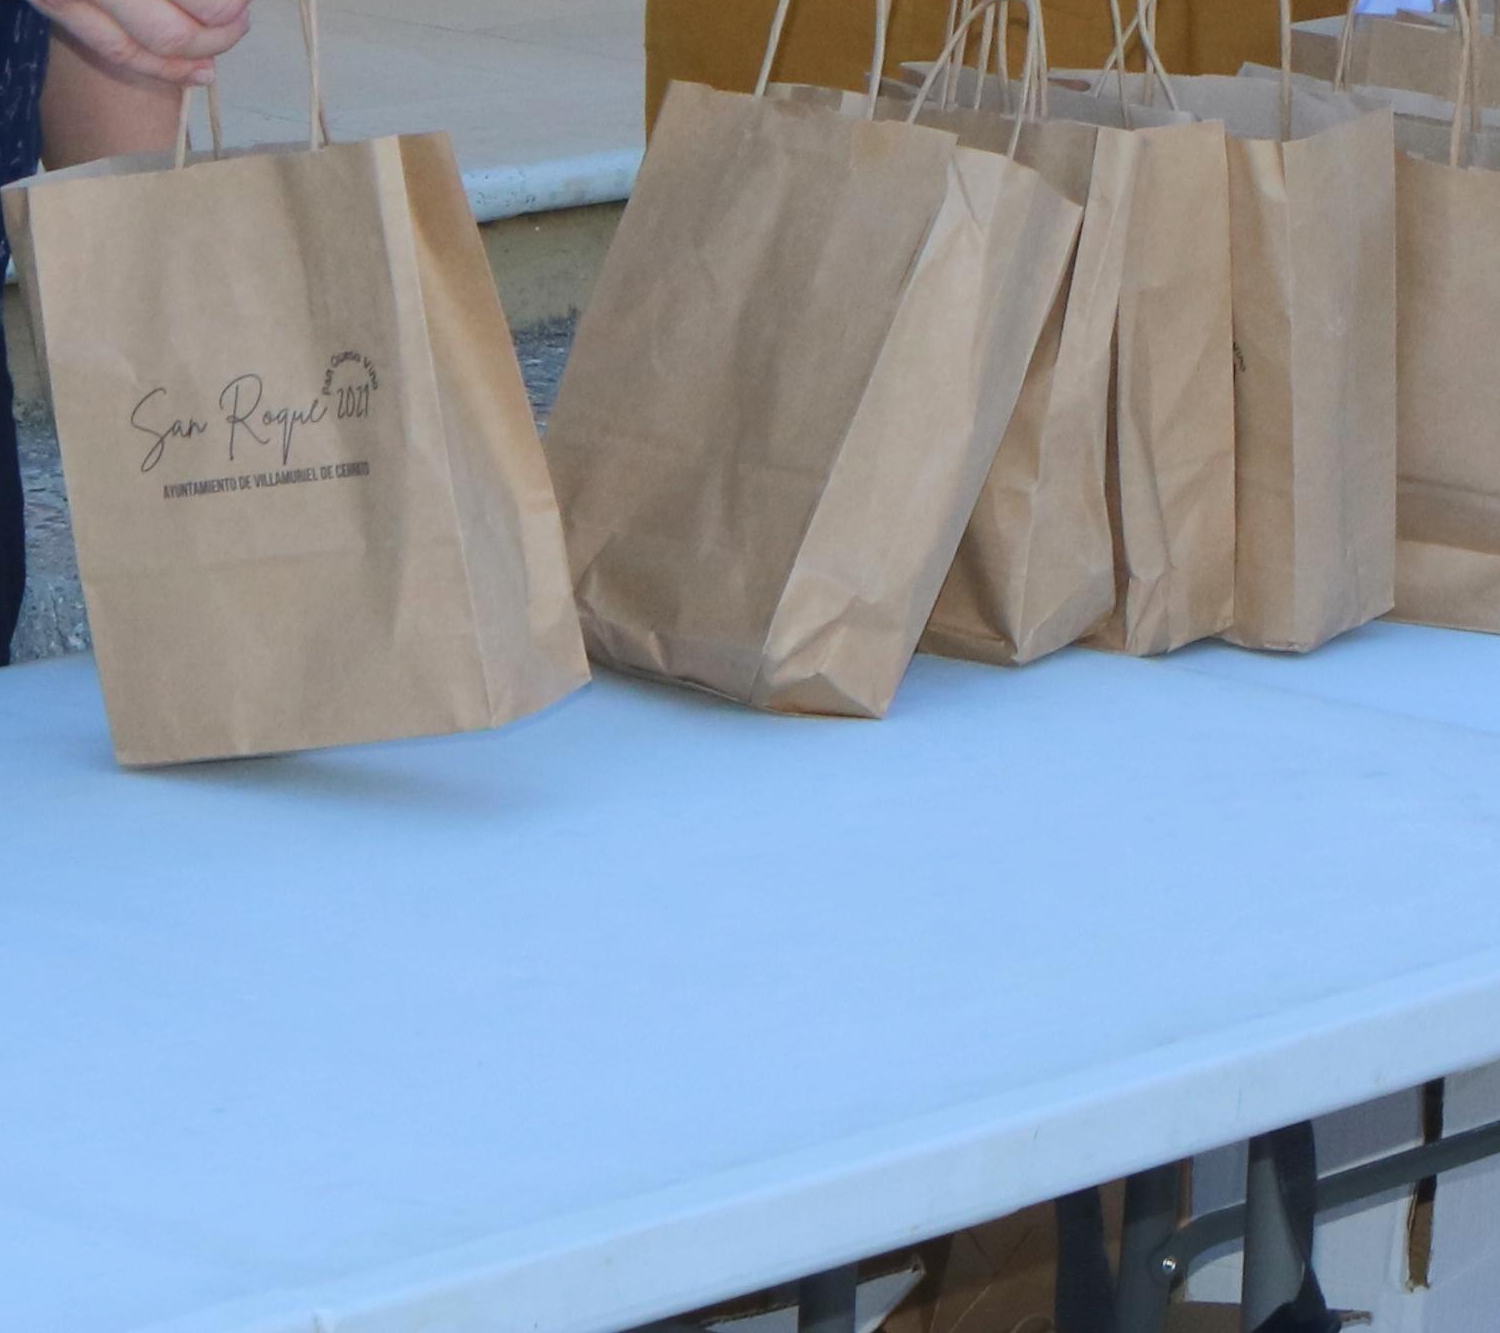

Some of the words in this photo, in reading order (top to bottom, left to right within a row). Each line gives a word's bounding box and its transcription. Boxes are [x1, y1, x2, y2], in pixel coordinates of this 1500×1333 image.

[363, 356, 379, 390] Vino
[130, 387, 209, 473] San
[219, 373, 328, 466] Roque
[337, 383, 369, 420] 2021
[163, 477, 237, 500] AYUNTAMIENTO
[239, 475, 251, 491] DE
[252, 467, 319, 488] VILLAMURIEL
[320, 466, 334, 480] DE
